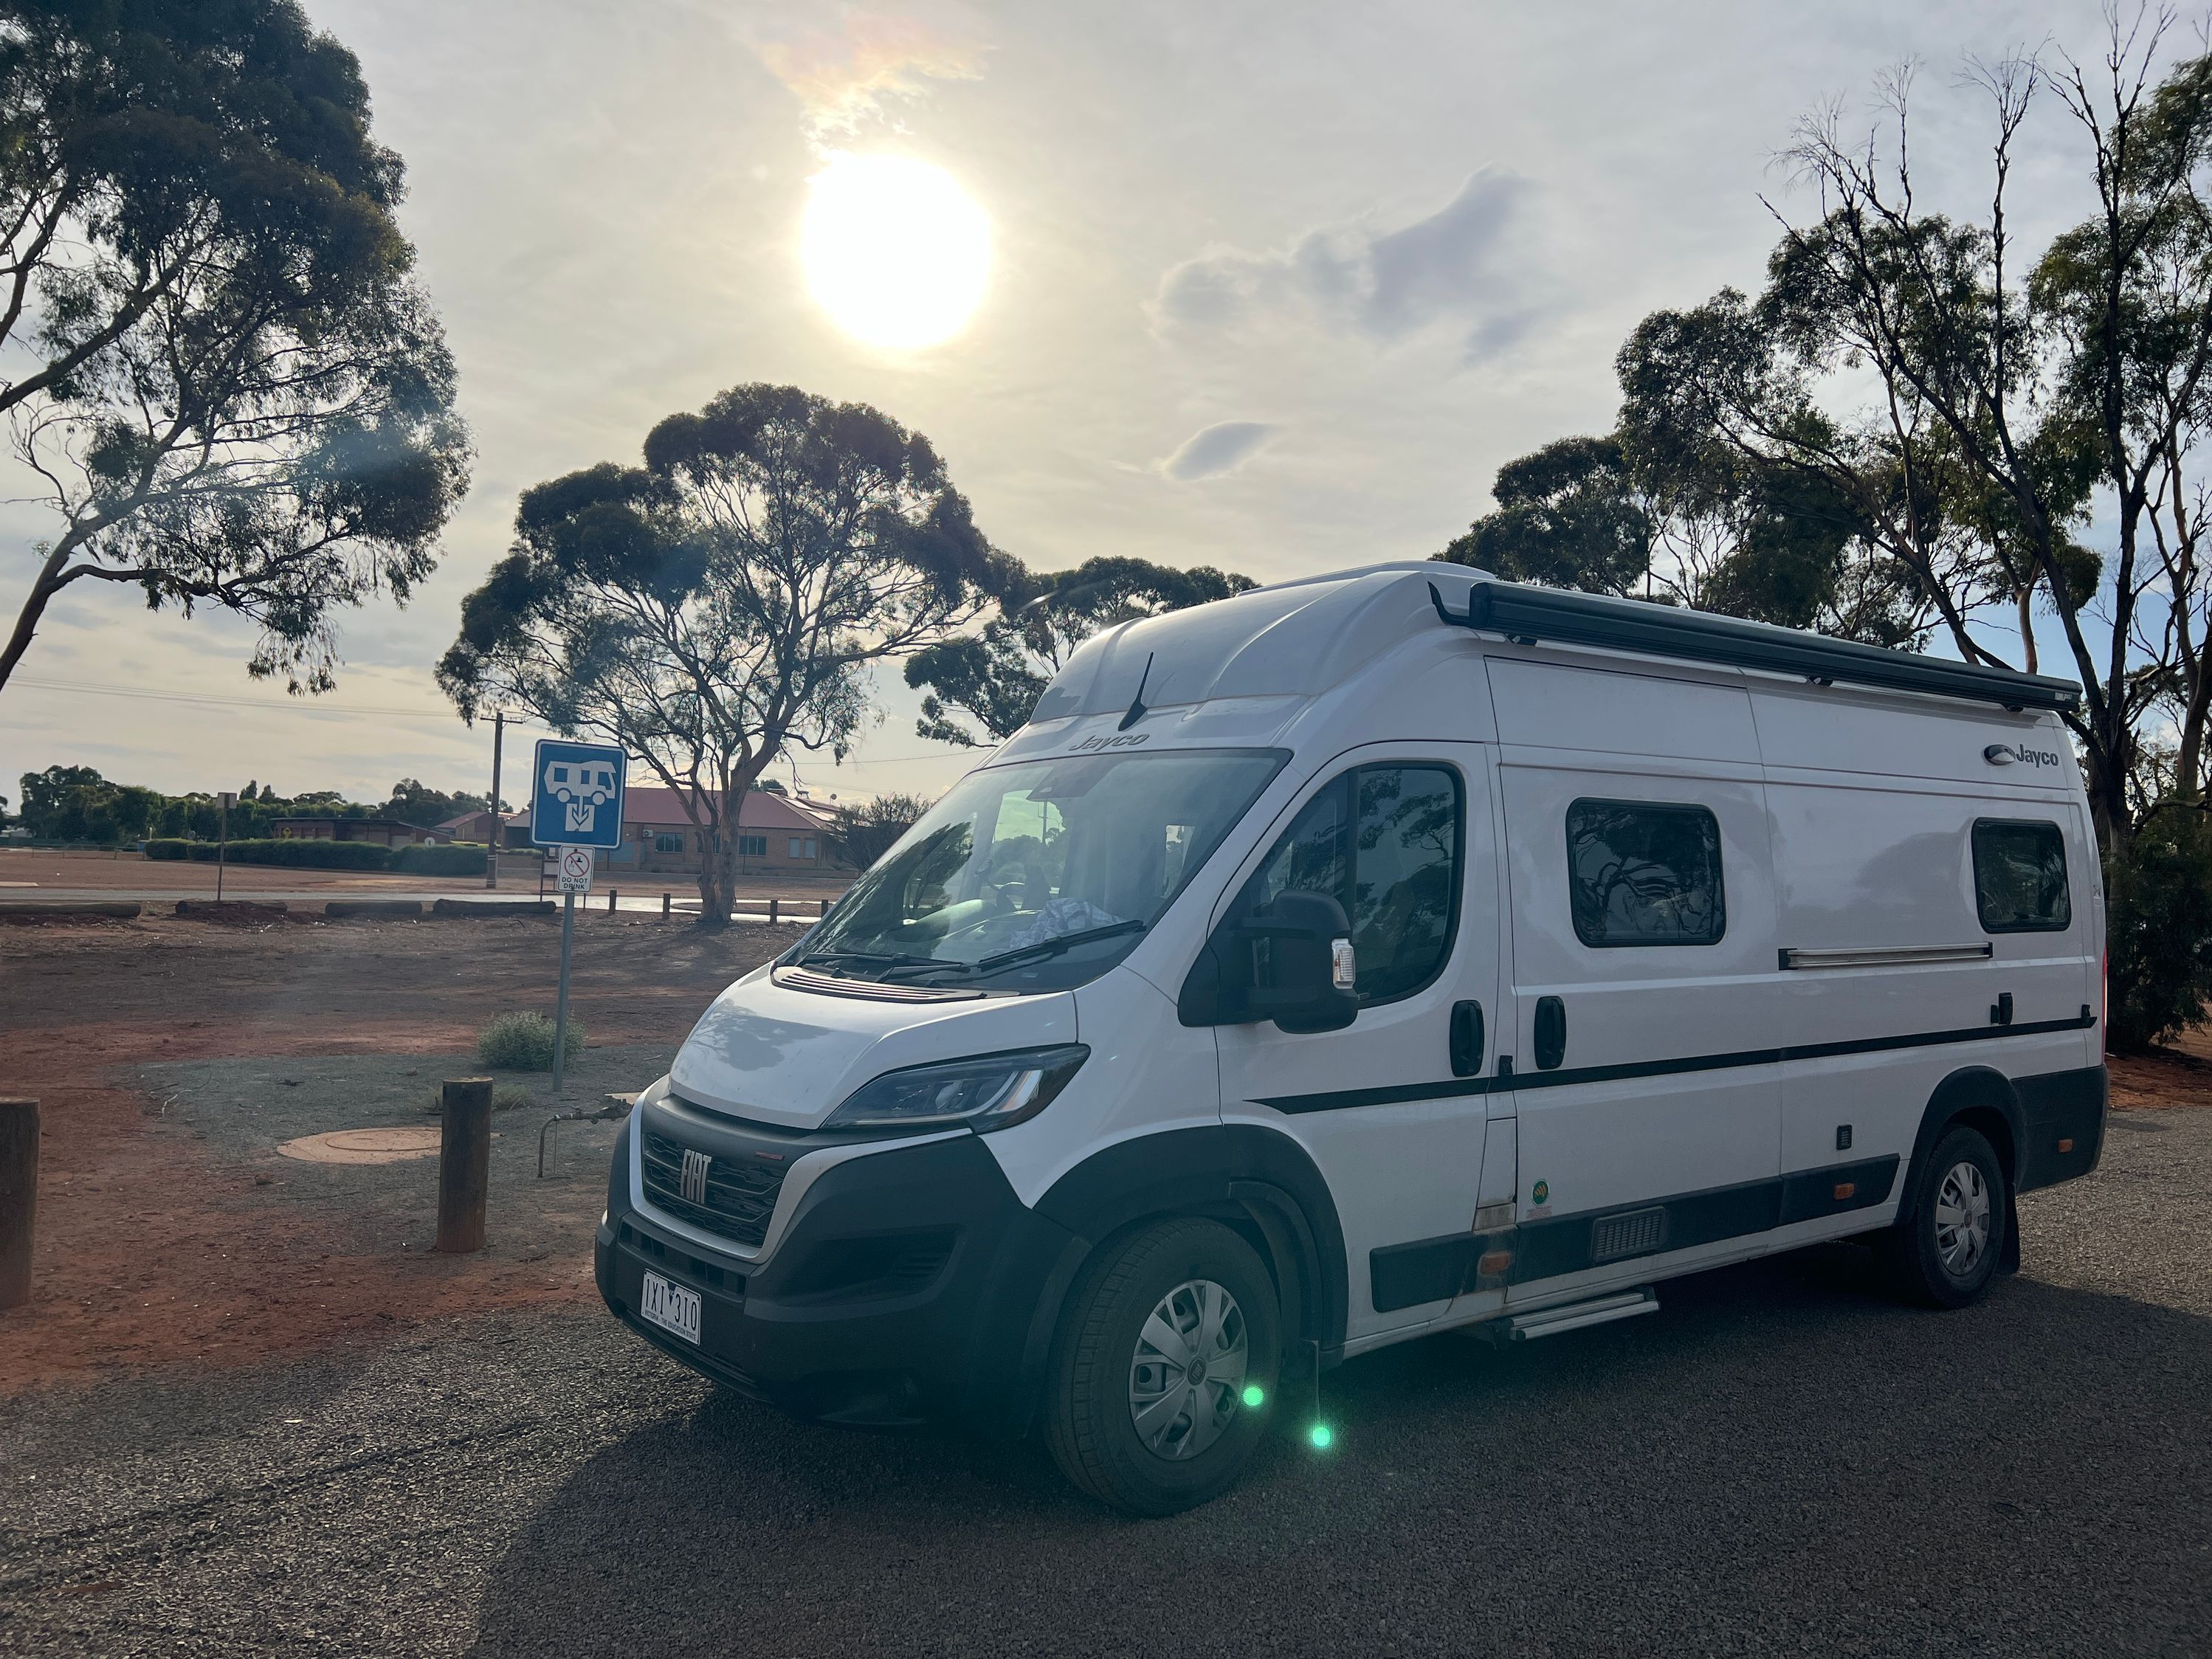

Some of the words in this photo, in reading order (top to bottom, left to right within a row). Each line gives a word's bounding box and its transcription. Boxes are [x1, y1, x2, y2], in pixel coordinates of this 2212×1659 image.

[1069, 734, 1150, 751] Jayco
[2016, 744, 2059, 768] Jayco
[680, 1148, 712, 1204] FIAT
